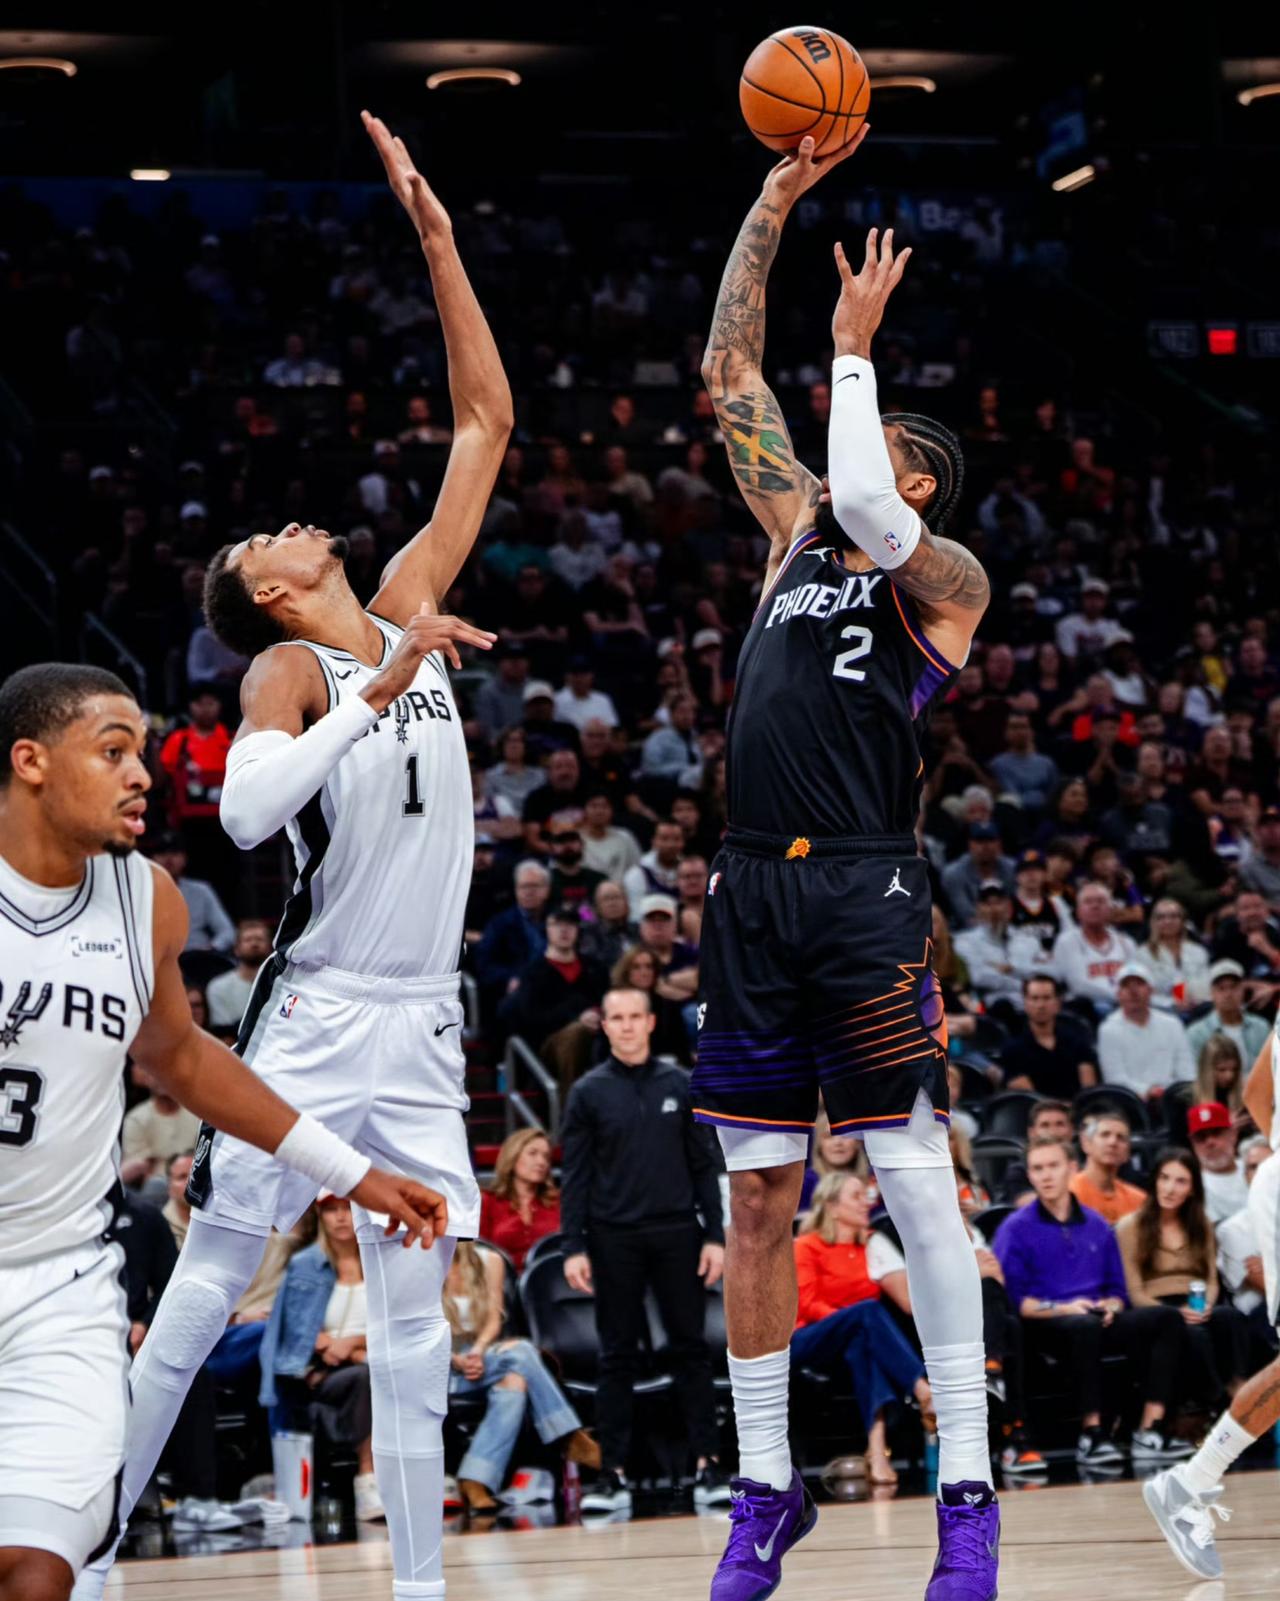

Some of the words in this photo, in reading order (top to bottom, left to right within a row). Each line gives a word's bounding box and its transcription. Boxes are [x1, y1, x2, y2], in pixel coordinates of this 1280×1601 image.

[765, 575, 883, 629] PHOENIX
[832, 625, 873, 682] 2
[363, 689, 452, 745] URS
[402, 753, 425, 817] 1
[78, 942, 116, 953] LEDGER
[0, 980, 126, 1049] URS
